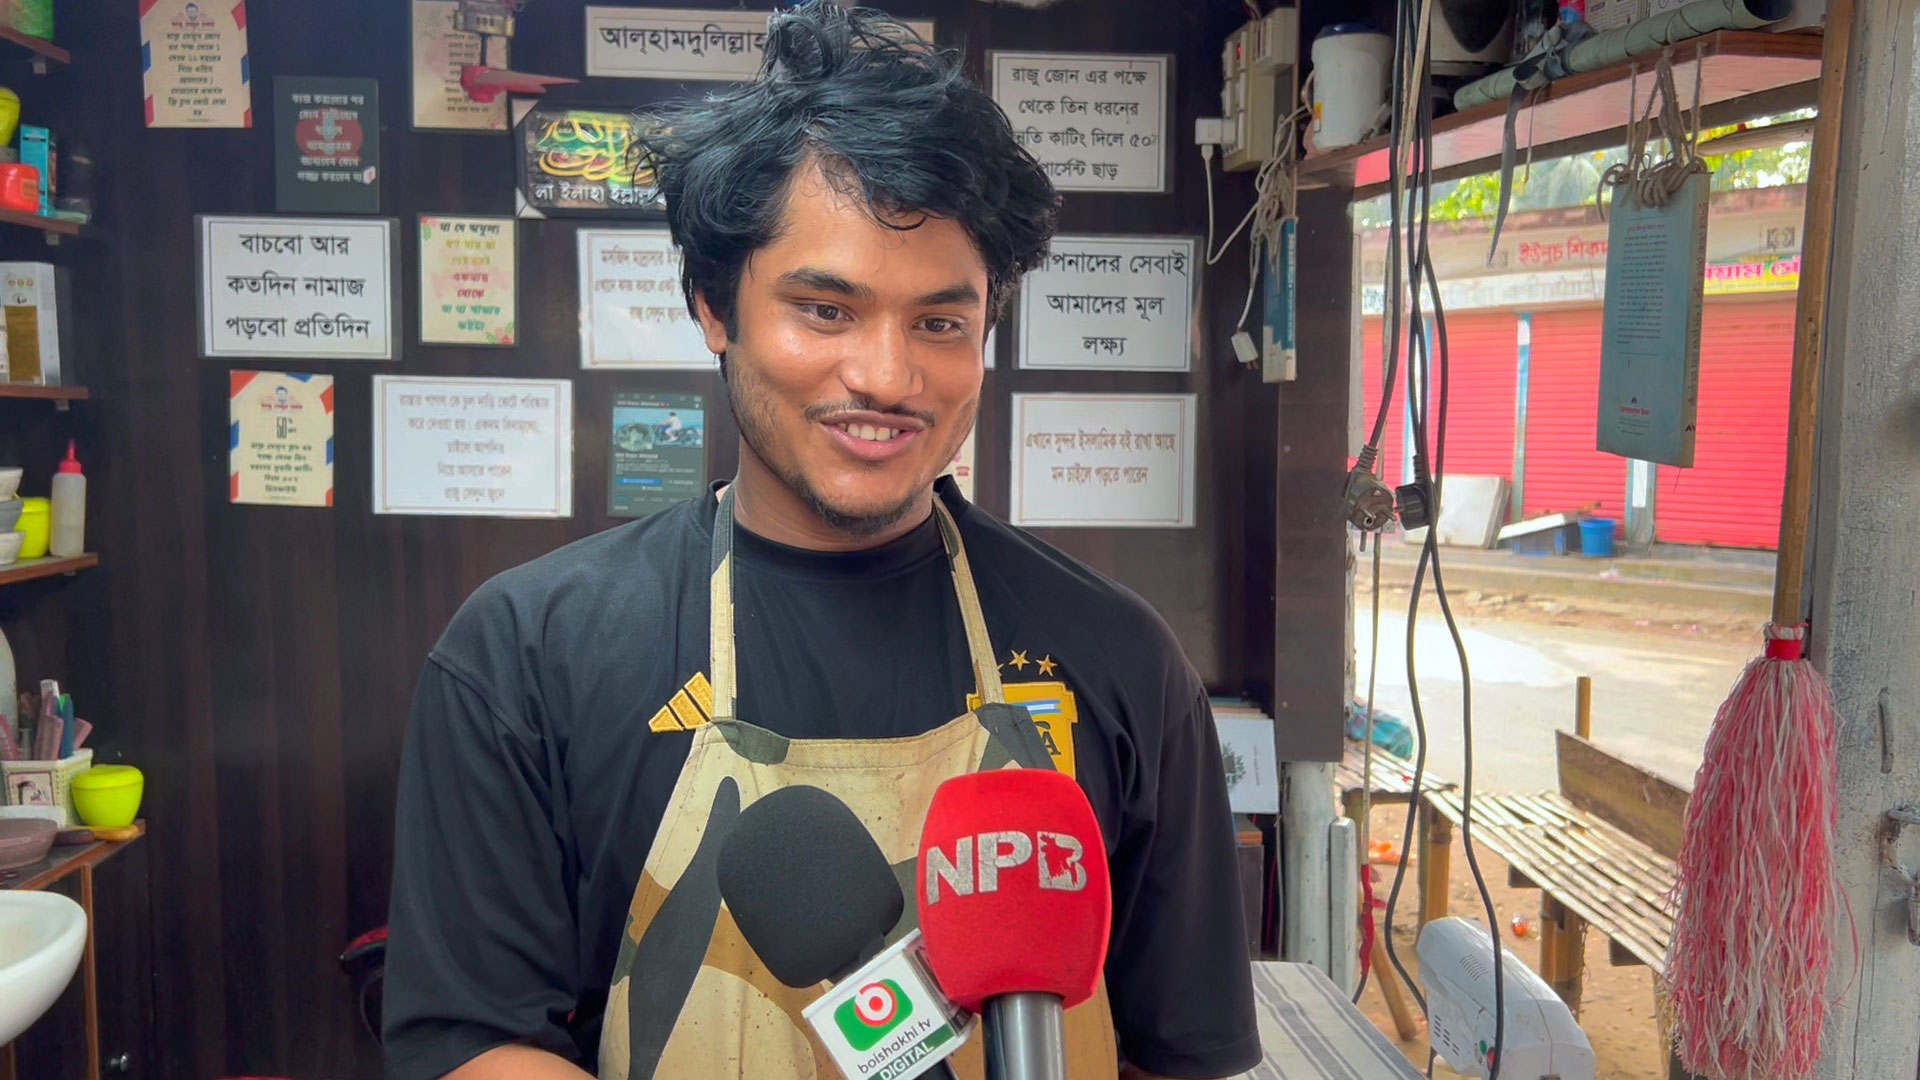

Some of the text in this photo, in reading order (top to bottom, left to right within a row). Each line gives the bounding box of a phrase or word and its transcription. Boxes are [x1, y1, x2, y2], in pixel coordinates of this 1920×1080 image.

[1012, 68, 1148, 86] রাজু জোন এর পক্ষে
[1018, 96, 1140, 117] থেকে তিন ধরনের
[1047, 126, 1087, 148] কাটিং
[1091, 128, 1124, 148] দিলে
[1092, 162, 1119, 180] ছাড়
[240, 234, 350, 256] বাচবো আর
[1130, 250, 1188, 277] সেবাই
[226, 269, 366, 298] কতদিন নামাজ
[1046, 294, 1165, 322] আমাদের মূল
[226, 312, 372, 341] পড়বো প্রতিদিন
[1082, 335, 1128, 356] লক্ষ্য
[925, 830, 1088, 906] NPB
[858, 1018, 931, 1074] boishakhi tv
[880, 1041, 934, 1080] DIGITAL
